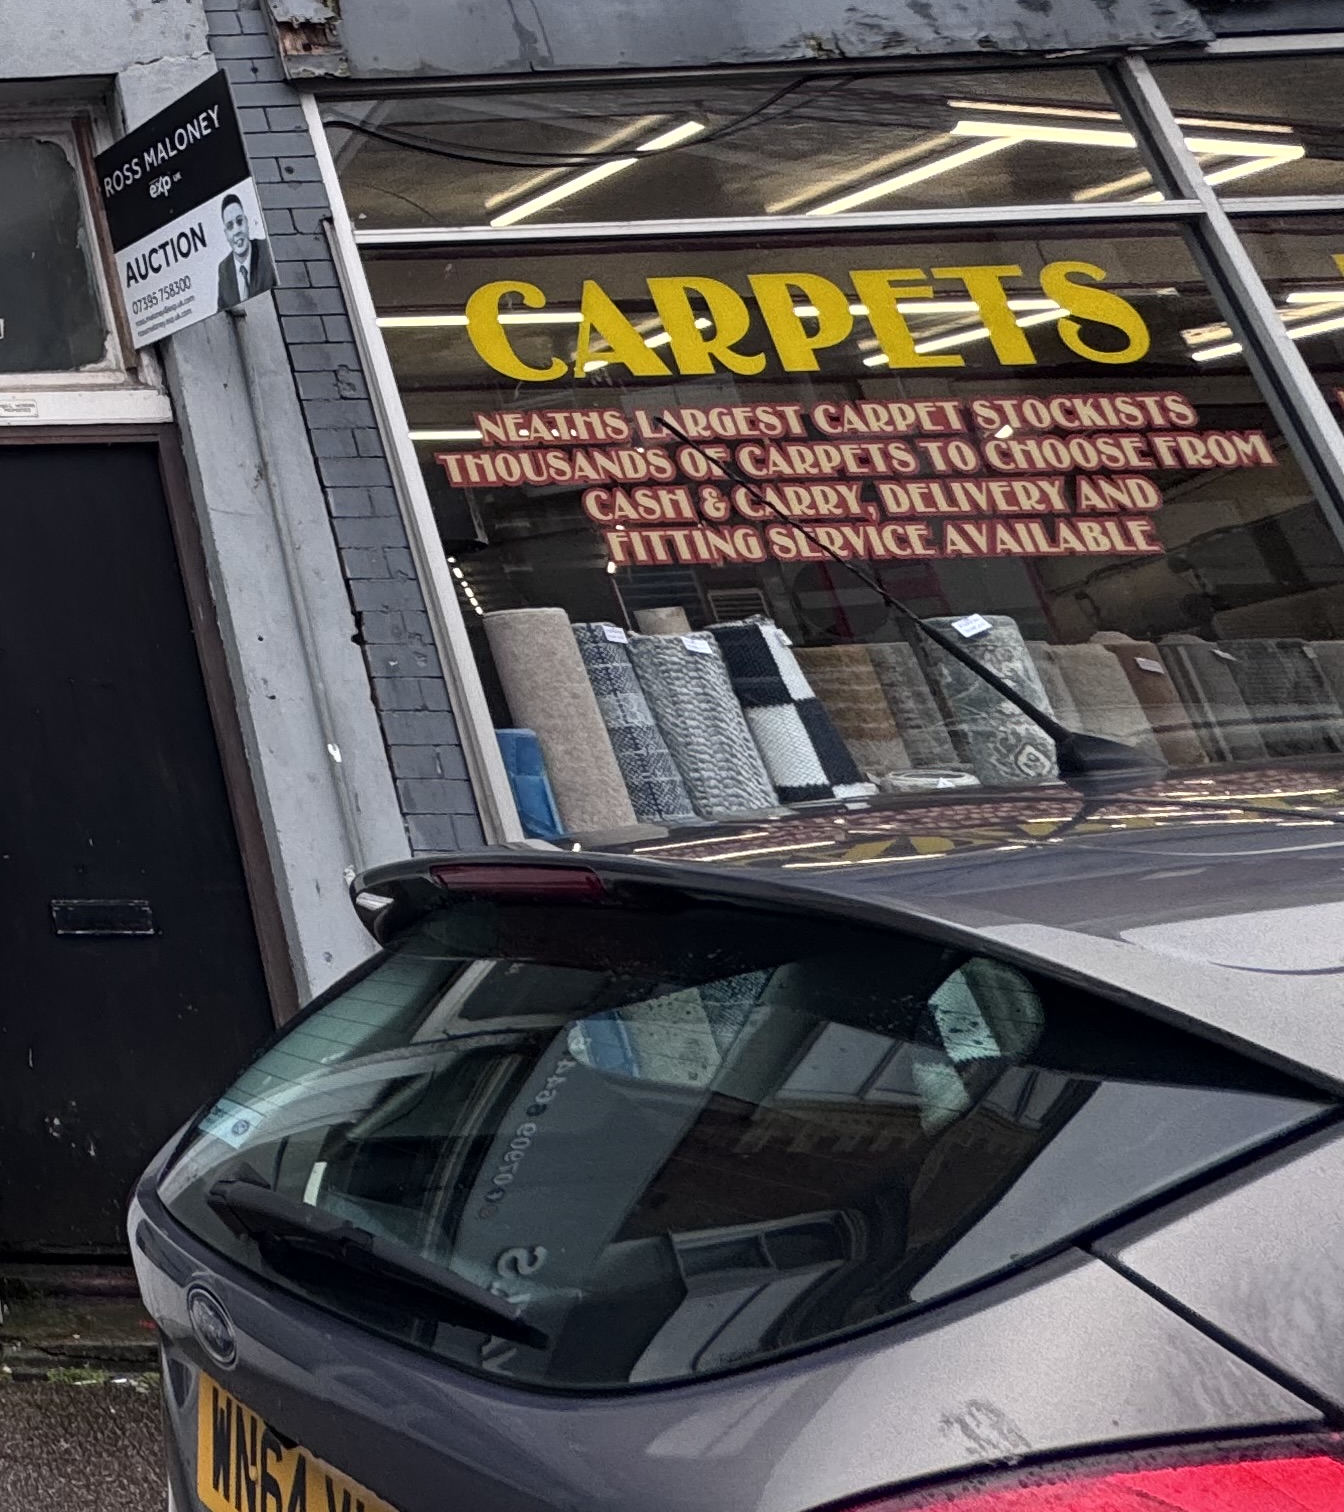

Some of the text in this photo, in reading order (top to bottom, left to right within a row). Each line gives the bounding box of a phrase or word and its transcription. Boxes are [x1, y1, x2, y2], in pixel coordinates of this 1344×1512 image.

[103, 104, 222, 198] ROSS MALONEY
[148, 174, 172, 199] exp
[125, 221, 208, 289] AUCTION
[158, 275, 192, 302] 758300
[463, 260, 1152, 382] CARPETS
[476, 392, 1198, 446] NEATHS LARGEST CARPET STOCKISTS
[437, 431, 1277, 486] THOUSANDS OF CARPETS TO CHOOSE FROM
[584, 474, 1163, 523] CASH & CARRY, DELIVERY AND
[606, 516, 1164, 565] FITTING SERVICE AVAILABLE
